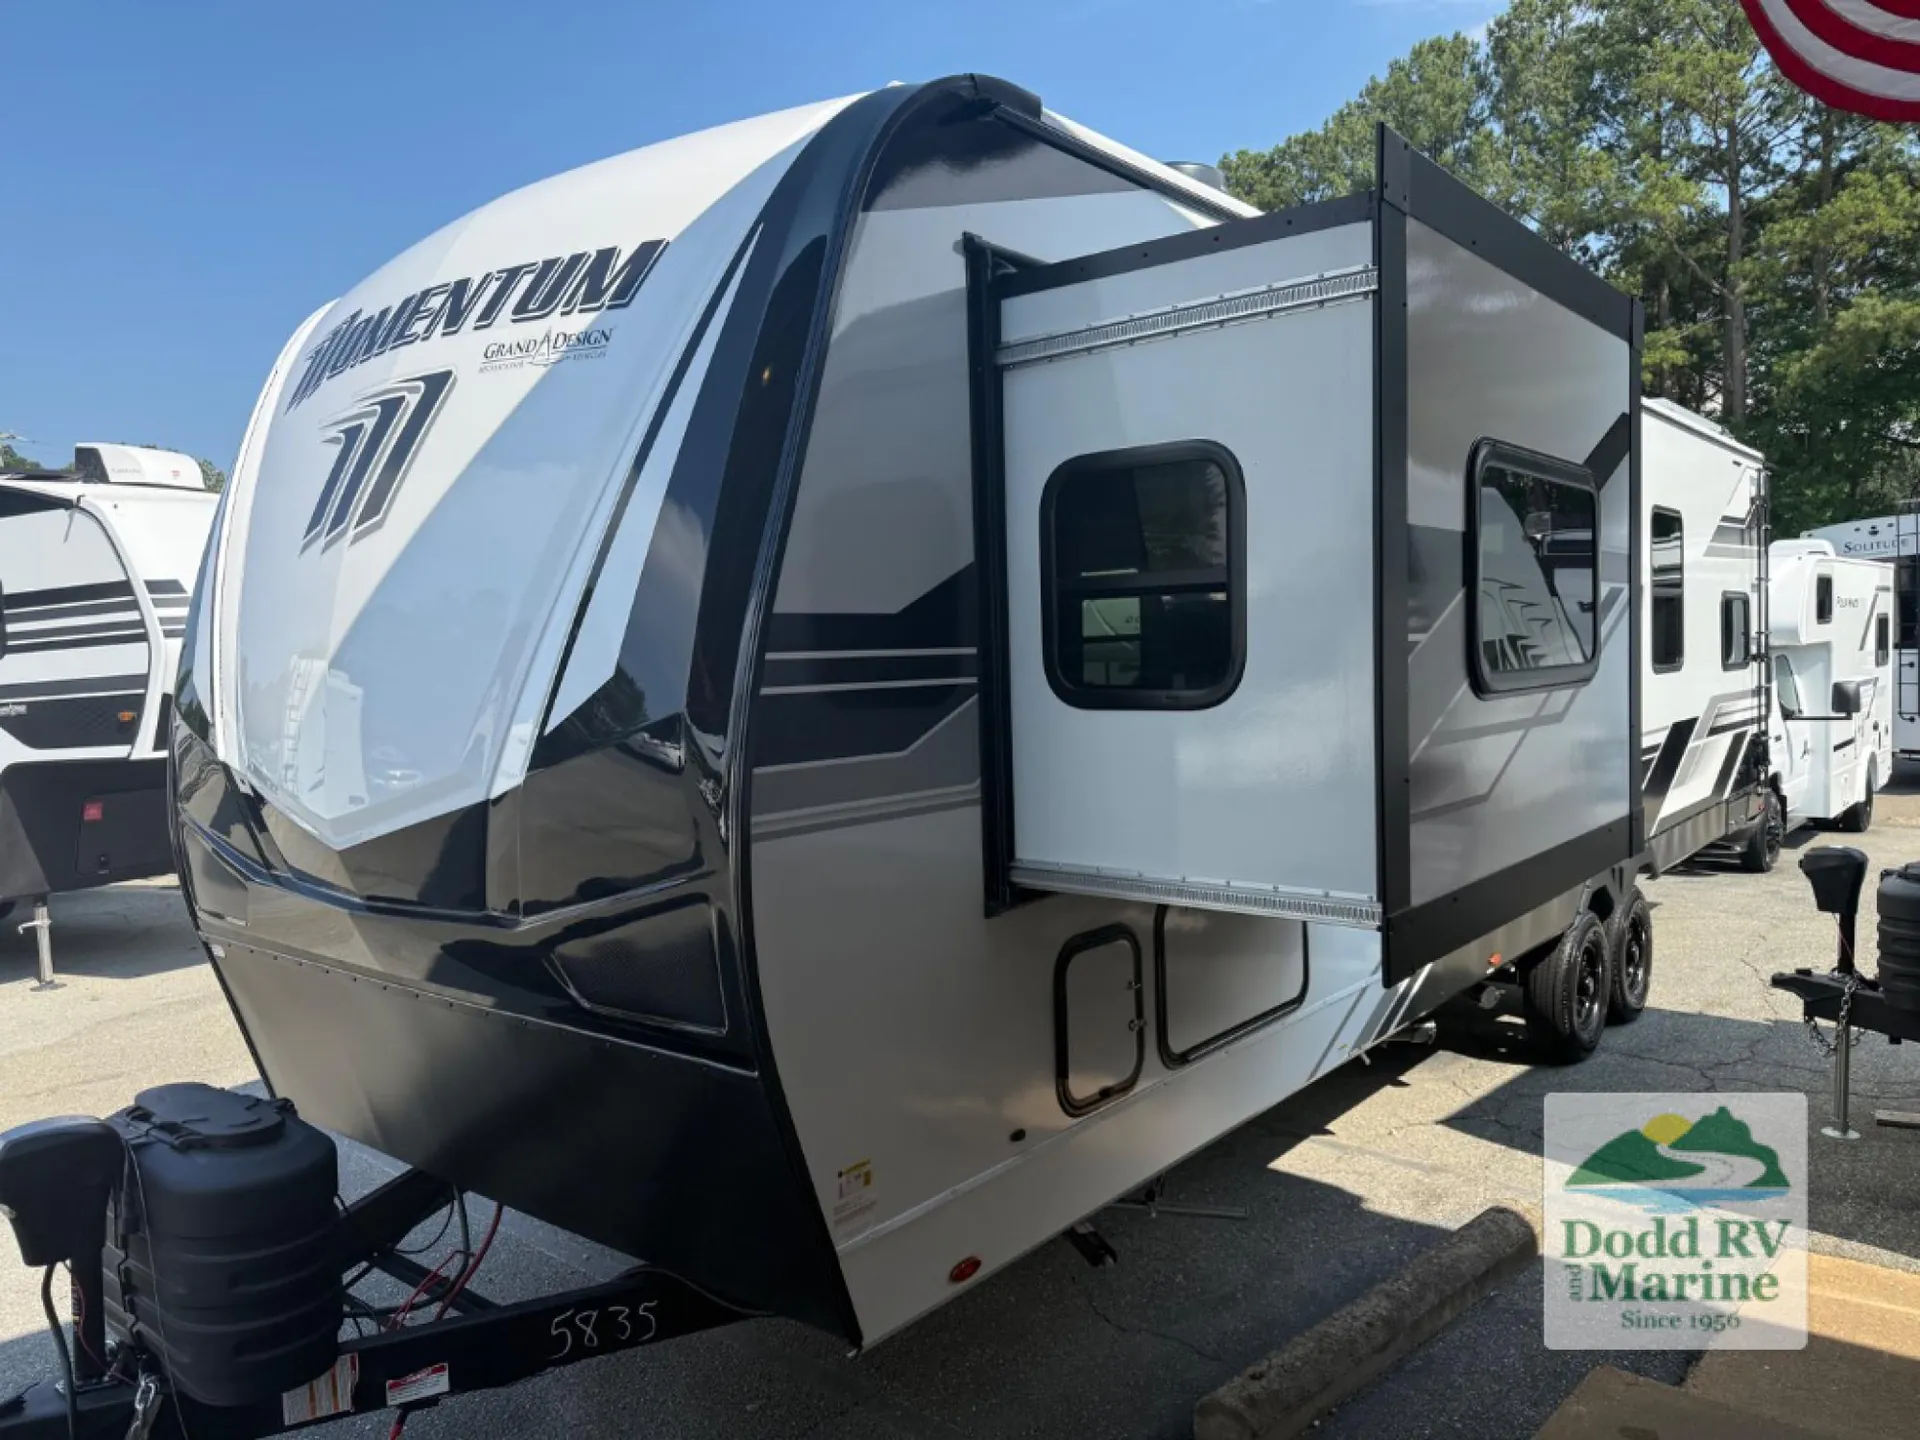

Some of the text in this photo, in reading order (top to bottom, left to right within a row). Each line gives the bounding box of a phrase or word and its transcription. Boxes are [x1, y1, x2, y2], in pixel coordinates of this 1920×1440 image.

[284, 237, 670, 415] MOMENTUM
[483, 328, 614, 359] GRAND DESIGN
[548, 1299, 658, 1359] 5835
